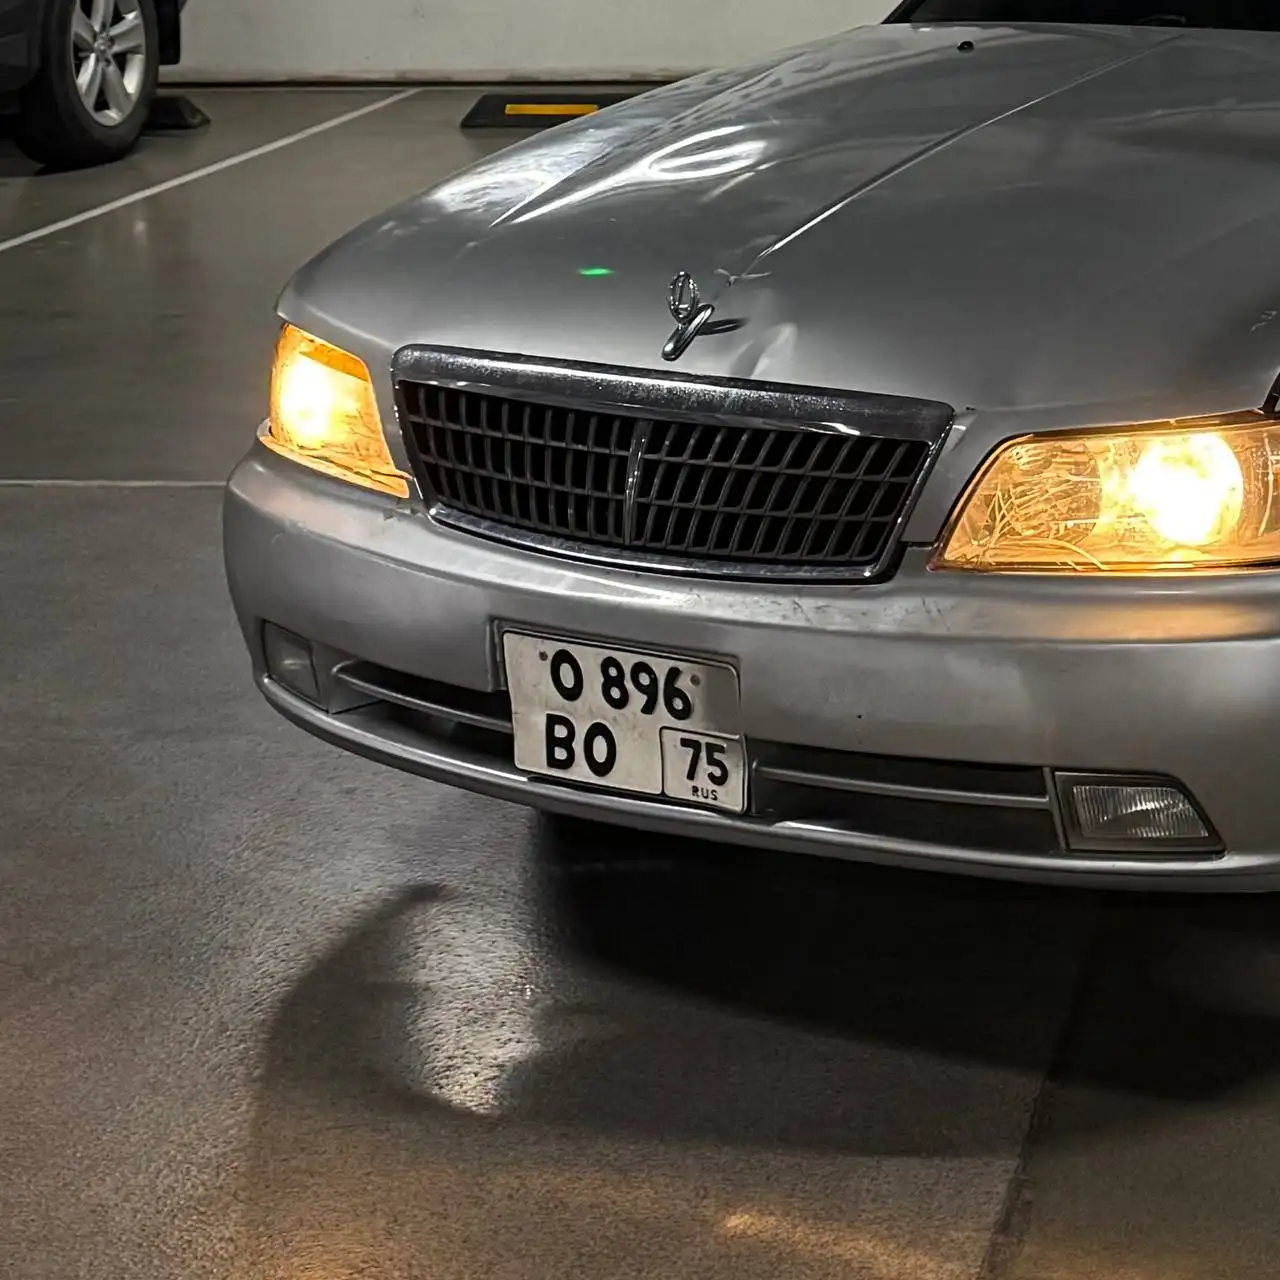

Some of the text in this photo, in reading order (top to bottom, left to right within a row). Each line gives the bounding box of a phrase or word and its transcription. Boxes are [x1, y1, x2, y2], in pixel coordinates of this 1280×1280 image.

[601, 656, 693, 721] 896
[680, 738, 729, 787] 75
[691, 786, 719, 802] RUS
